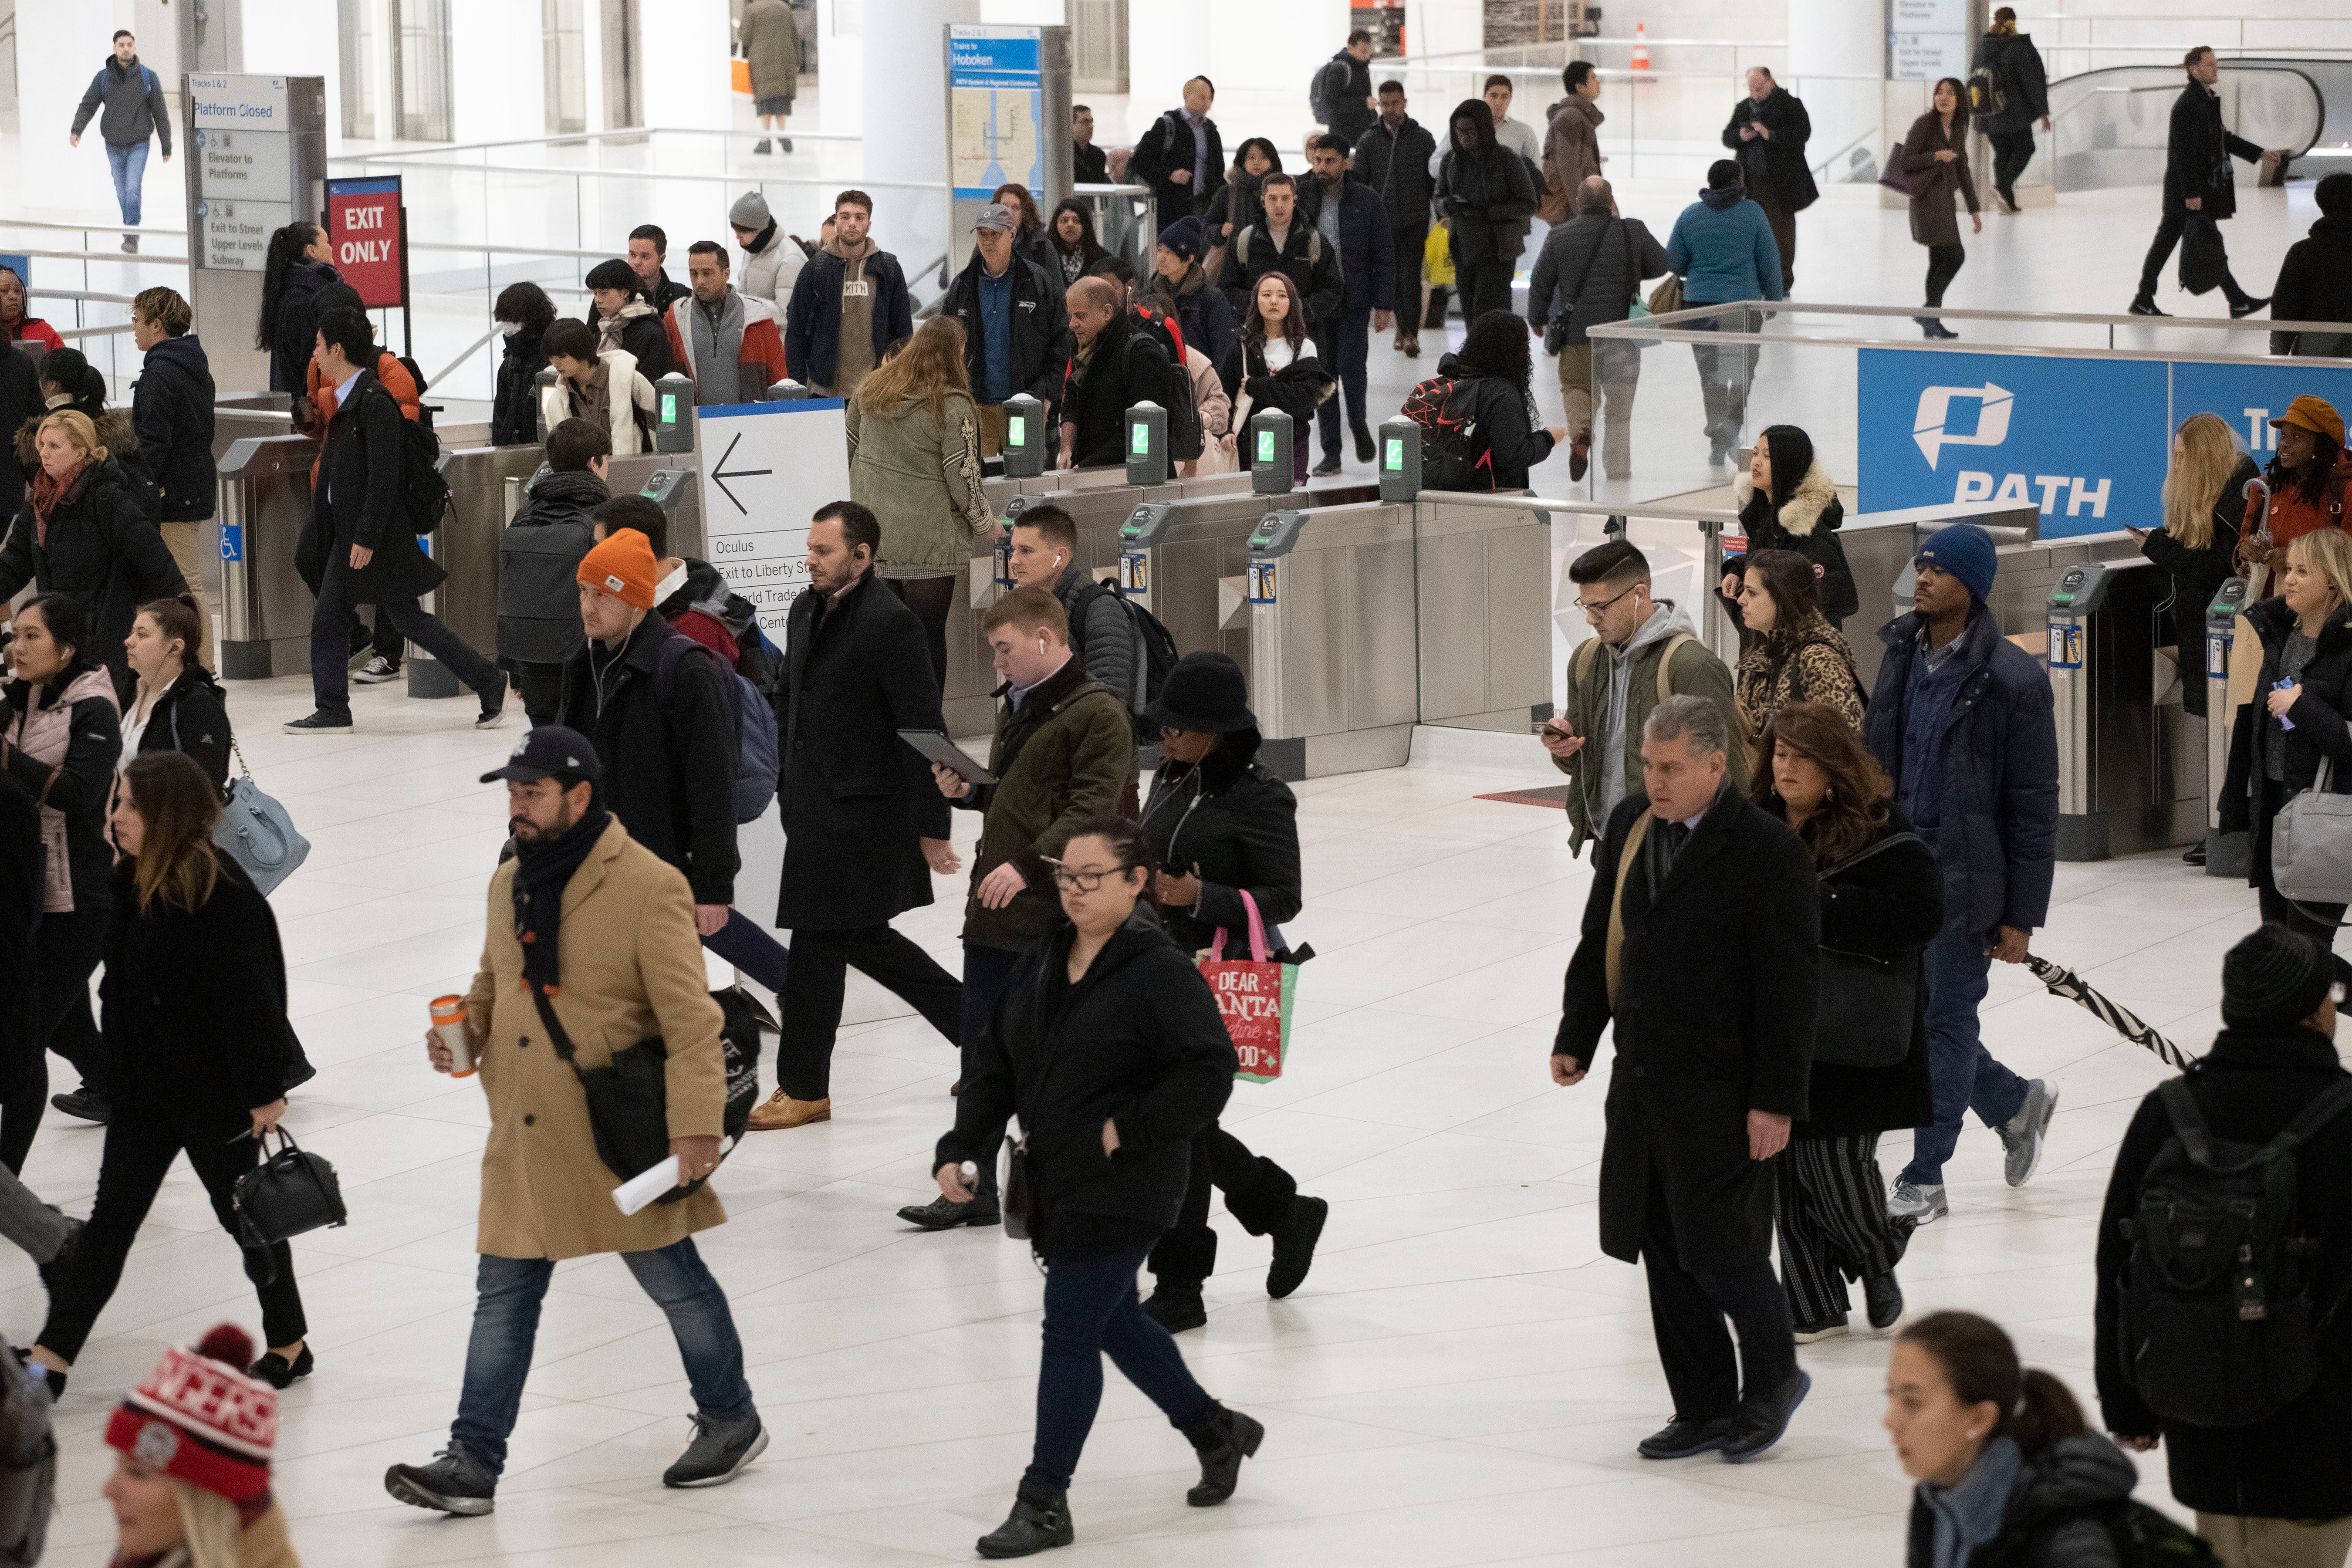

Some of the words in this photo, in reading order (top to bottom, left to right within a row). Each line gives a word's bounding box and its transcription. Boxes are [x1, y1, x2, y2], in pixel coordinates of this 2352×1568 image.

[953, 54, 993, 65] Hoboken
[192, 79, 211, 88] Tracks
[195, 103, 236, 116] Platform
[240, 104, 272, 118] Closed
[208, 152, 241, 163] Elevator
[244, 155, 253, 164] to
[209, 168, 248, 180] Platforms
[345, 206, 384, 230] EXIT
[211, 222, 226, 233] Exit
[229, 223, 237, 233] to
[240, 224, 264, 235] Street
[212, 239, 236, 251] Upper
[239, 240, 263, 251] Levels
[341, 240, 392, 264] ONLY
[212, 254, 244, 268] Subway
[846, 284, 865, 293] KITH
[1953, 470, 2112, 518] PATH
[716, 540, 754, 554] Oculus
[719, 567, 739, 580] Exit
[741, 568, 753, 578] to
[756, 563, 793, 577] Liberty
[796, 561, 809, 574] St
[1134, 558, 1144, 587] MetroCard
[1262, 568, 1273, 597] MetroCard
[738, 591, 763, 604] orld
[765, 588, 797, 602] Trade
[2067, 630, 2079, 661] MetroCard
[2057, 670, 2067, 678] 256
[2216, 680, 2225, 689] 257
[1219, 971, 1259, 992] DEAR
[1215, 991, 1281, 1021] ANTA
[1227, 1017, 1262, 1041] efine
[1235, 1045, 1258, 1067] OD
